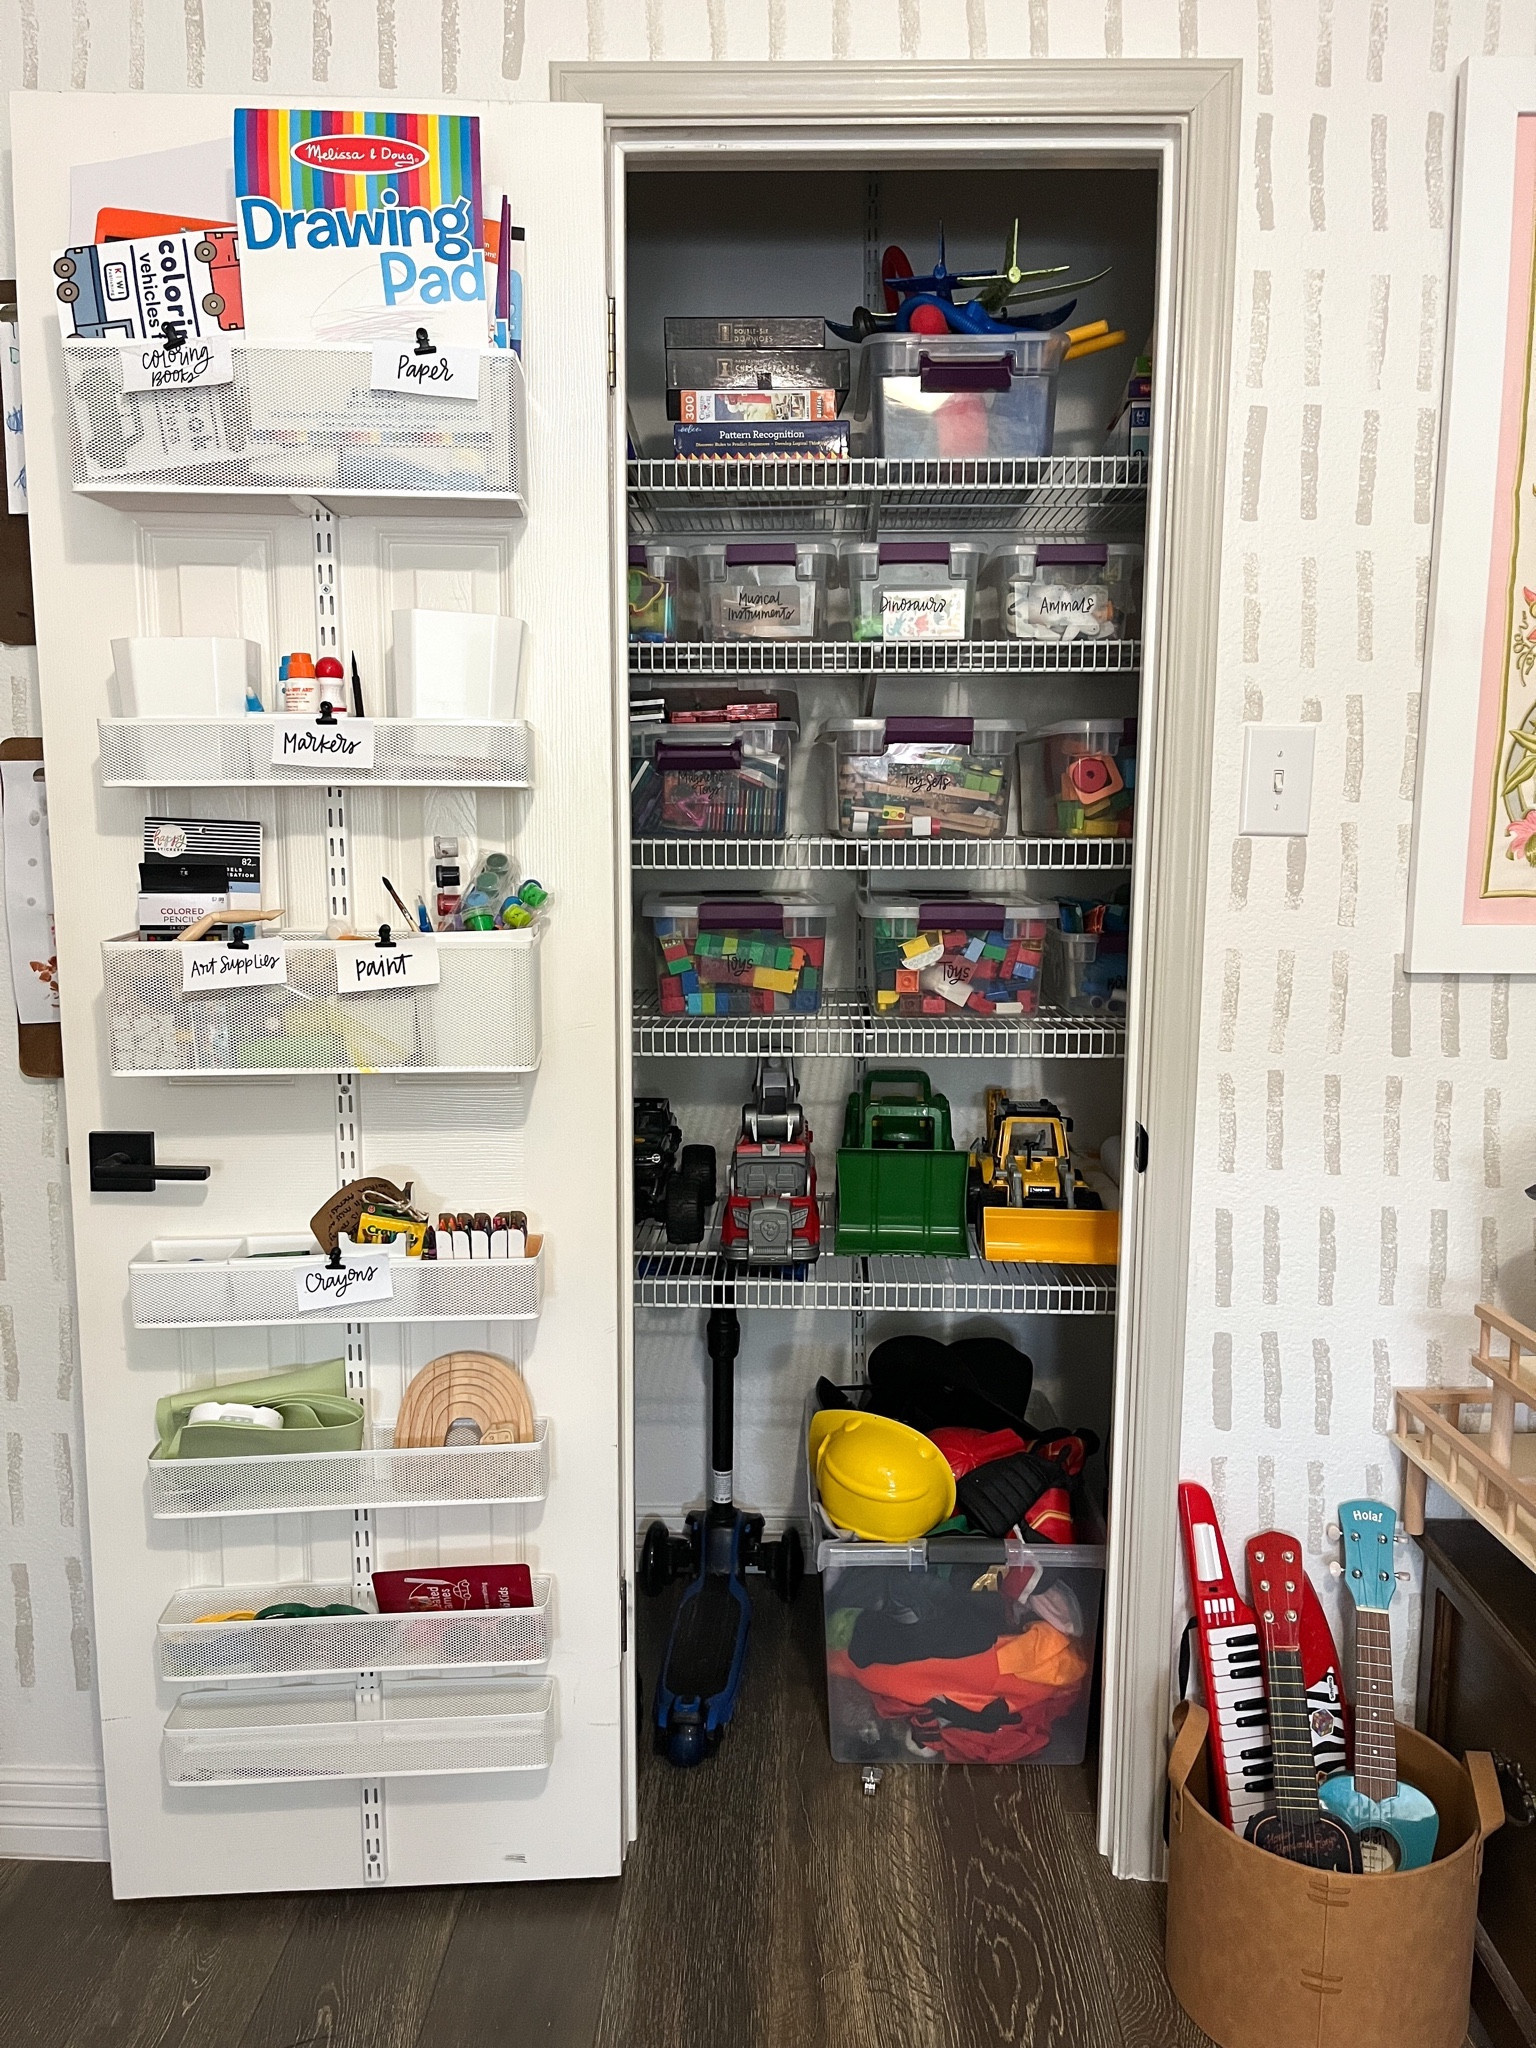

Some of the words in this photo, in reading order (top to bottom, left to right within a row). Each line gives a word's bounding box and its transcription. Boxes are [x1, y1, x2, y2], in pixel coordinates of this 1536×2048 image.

[305, 143, 365, 162] Melissa
[240, 190, 471, 262] Drawing
[380, 251, 486, 306] Pad
[140, 253, 161, 328] vehicles
[397, 355, 454, 384] Paper
[685, 396, 695, 420] 300
[719, 430, 751, 440] Pattern
[753, 430, 805, 441] Recognition
[739, 591, 783, 606] Musical
[880, 596, 947, 613] Dinosaurs
[1040, 597, 1095, 614] Animals
[728, 606, 795, 620] Instruments
[284, 731, 361, 754] Markers
[902, 773, 926, 793] Toy
[926, 773, 951, 791] Sets
[153, 829, 189, 848] happy
[241, 858, 252, 866] 82
[191, 957, 218, 978] Art
[721, 954, 754, 976] Toys
[938, 961, 970, 984] Toys
[305, 1266, 378, 1297] Crayons
[1352, 1509, 1383, 1523] Hola!
